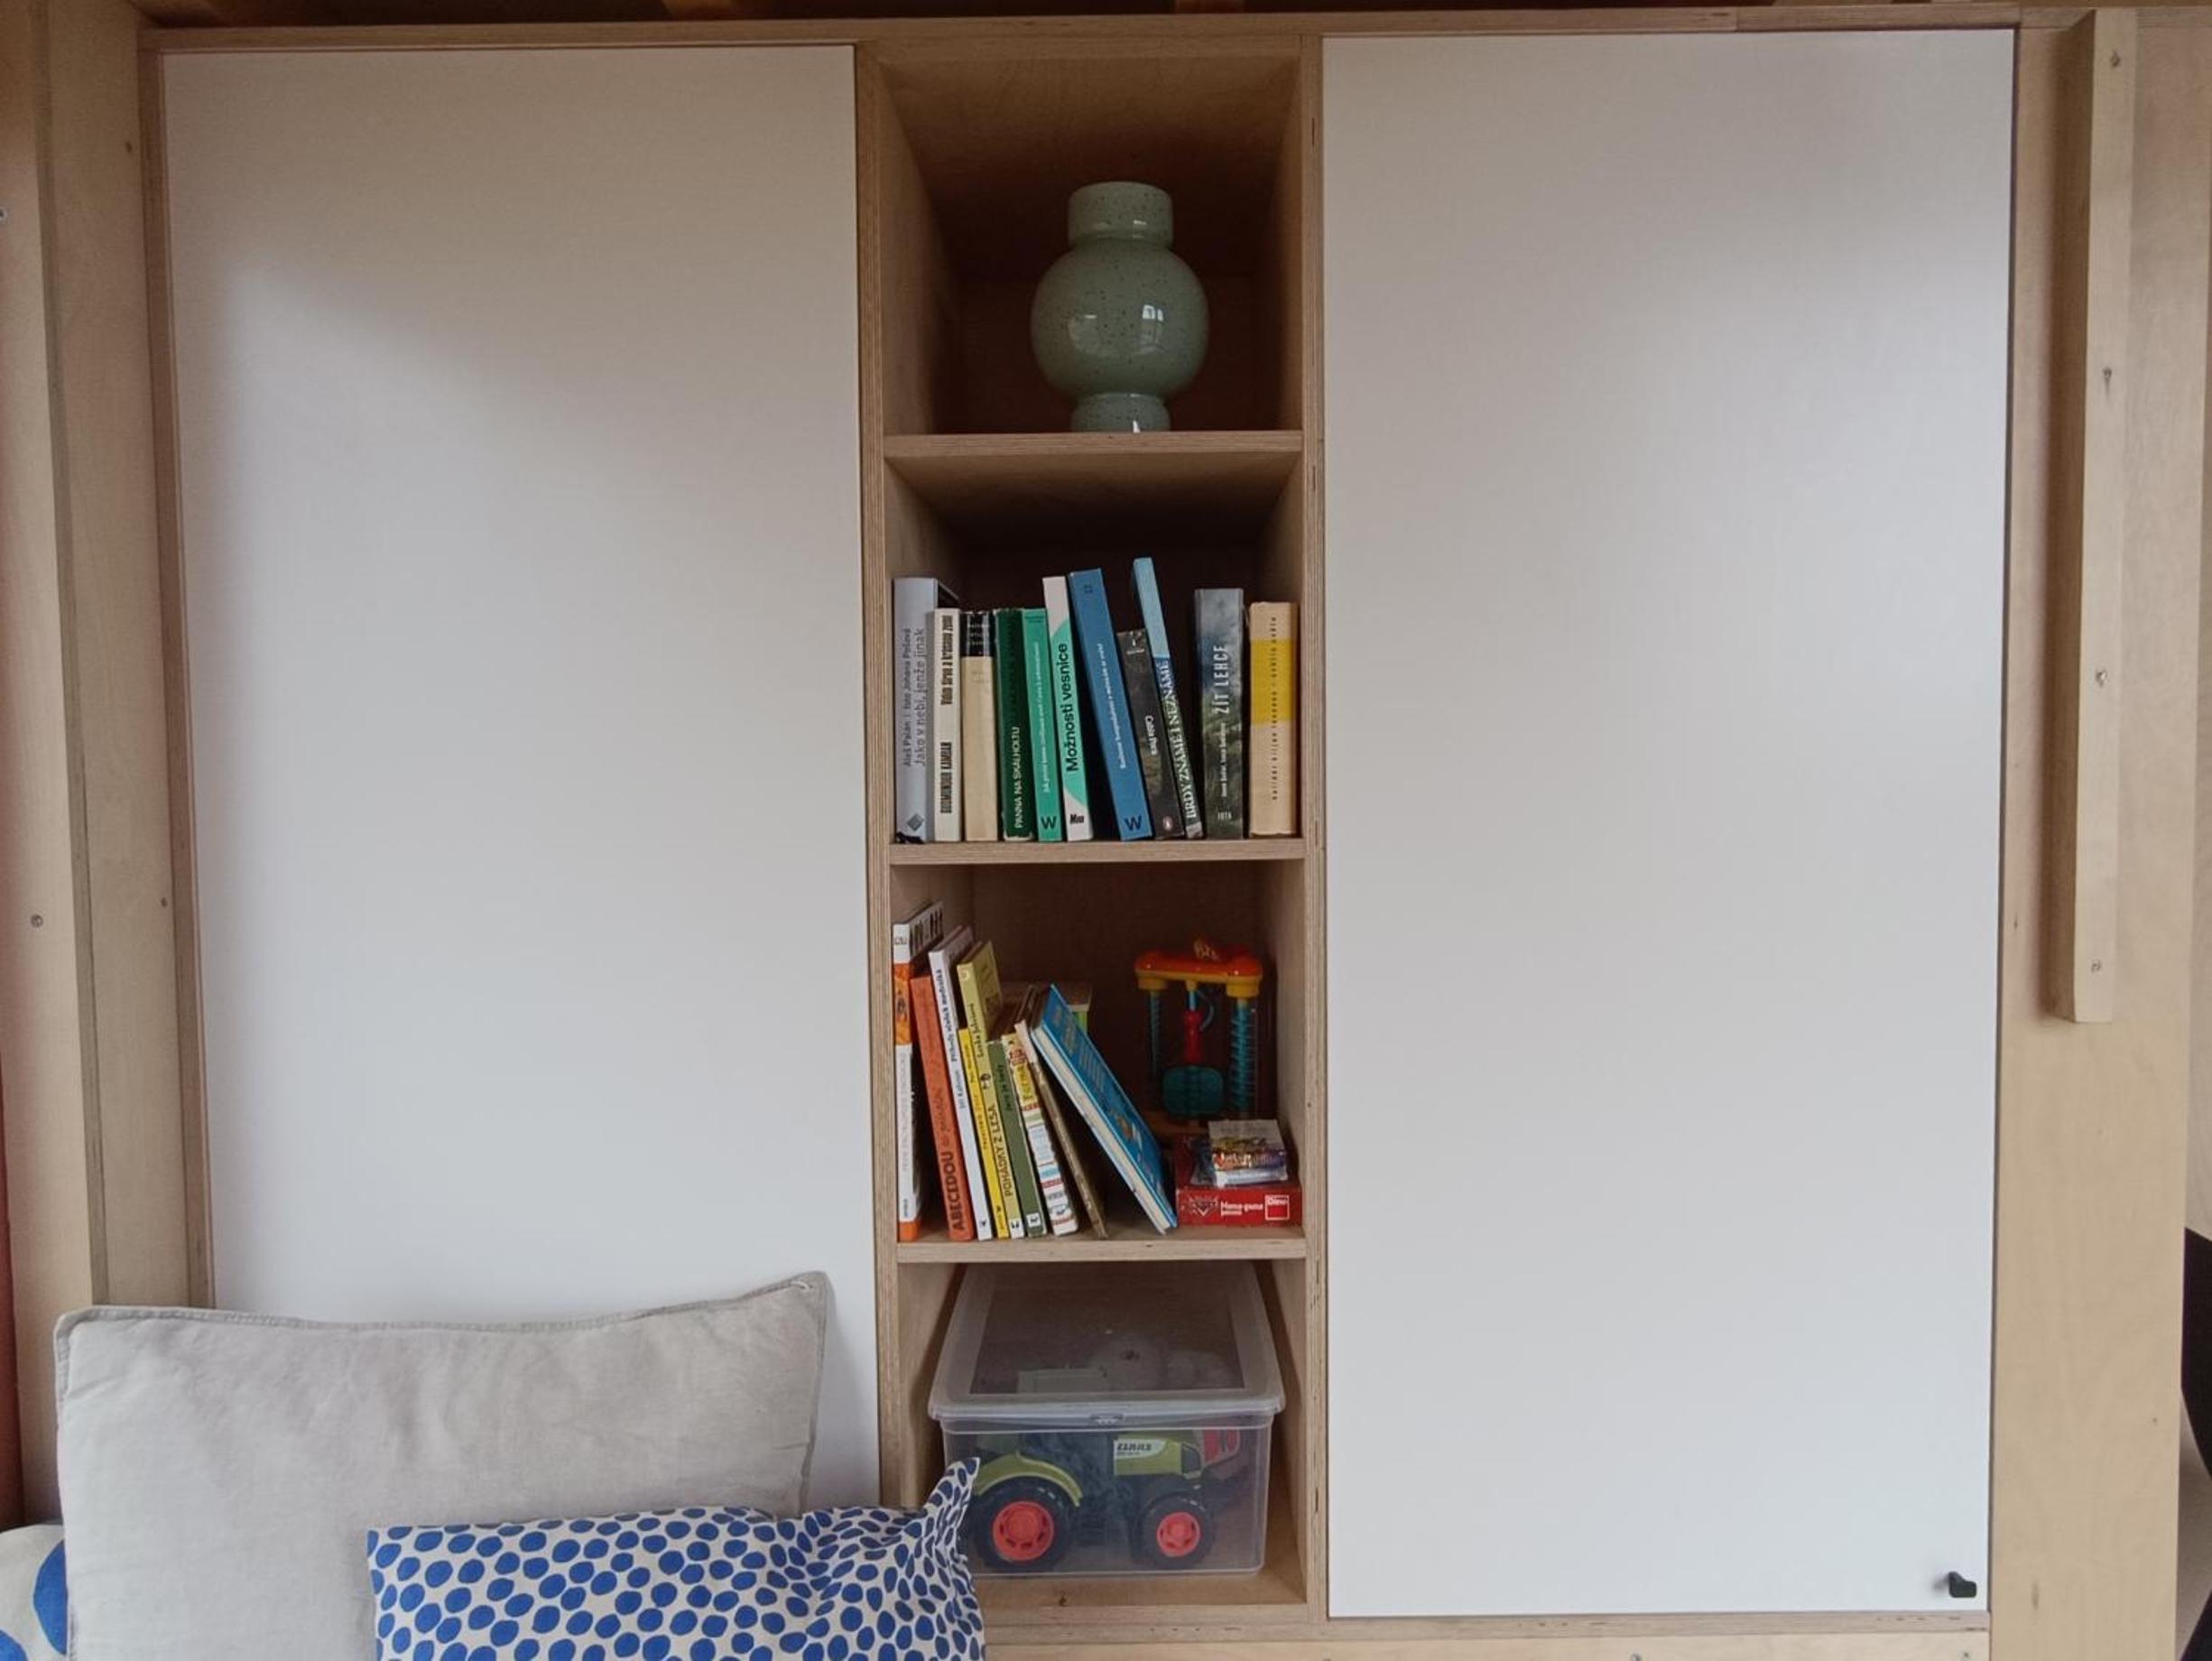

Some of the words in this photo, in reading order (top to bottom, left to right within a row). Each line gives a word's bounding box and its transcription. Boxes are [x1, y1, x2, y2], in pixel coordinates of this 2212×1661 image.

[913, 628, 925, 657] jinak
[913, 661, 928, 693] jenže
[1056, 643, 1074, 702] vesnice
[1212, 645, 1230, 686] LEHCE
[1156, 661, 1180, 727] NEZNÁMÉ
[1212, 692, 1230, 715] ŽÍT
[913, 696, 927, 725] nebi,
[914, 738, 926, 766] Jako
[1060, 703, 1080, 773] Možnosti
[1170, 735, 1189, 784] ZNÁMÉ
[1013, 780, 1022, 794] NA
[1181, 783, 1198, 819] BRDY
[1013, 797, 1023, 829] PANNA
[1041, 816, 1057, 830] W
[1125, 816, 1143, 830] W
[989, 1103, 1001, 1134] LESA
[993, 1135, 1003, 1145] Z
[941, 1151, 967, 1231] ABECEDOU
